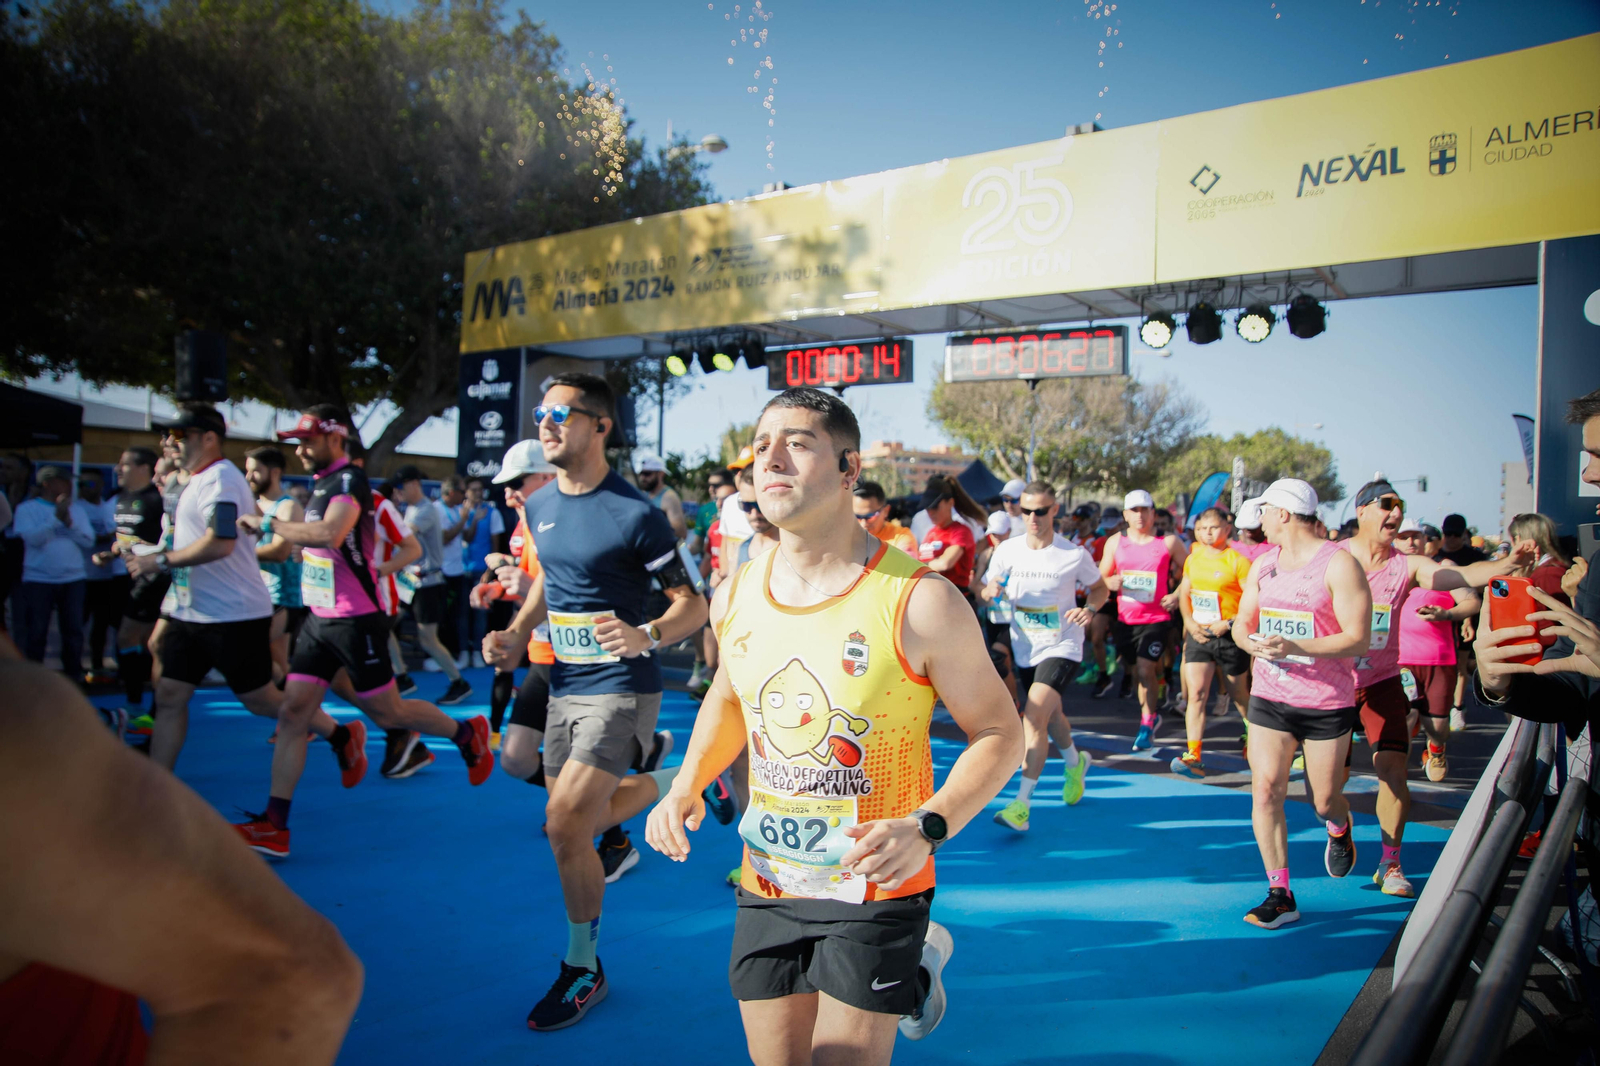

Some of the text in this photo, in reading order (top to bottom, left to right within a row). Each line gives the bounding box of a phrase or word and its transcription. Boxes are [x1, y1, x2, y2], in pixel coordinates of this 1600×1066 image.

[1484, 143, 1553, 165] CIUDAD
[1186, 189, 1275, 211] COOPERACIÓN
[1304, 188, 1325, 197] 2020
[960, 154, 1074, 254] 25
[1187, 209, 1216, 221] 2005
[553, 274, 675, 312] Almería 2024
[1024, 612, 1049, 626] 631
[1266, 618, 1307, 636] 1456
[555, 627, 602, 647] 108
[793, 766, 863, 782] DEPORTIVA
[798, 779, 871, 796] RUNNING
[791, 806, 810, 814] 2024
[759, 813, 828, 853] 682
